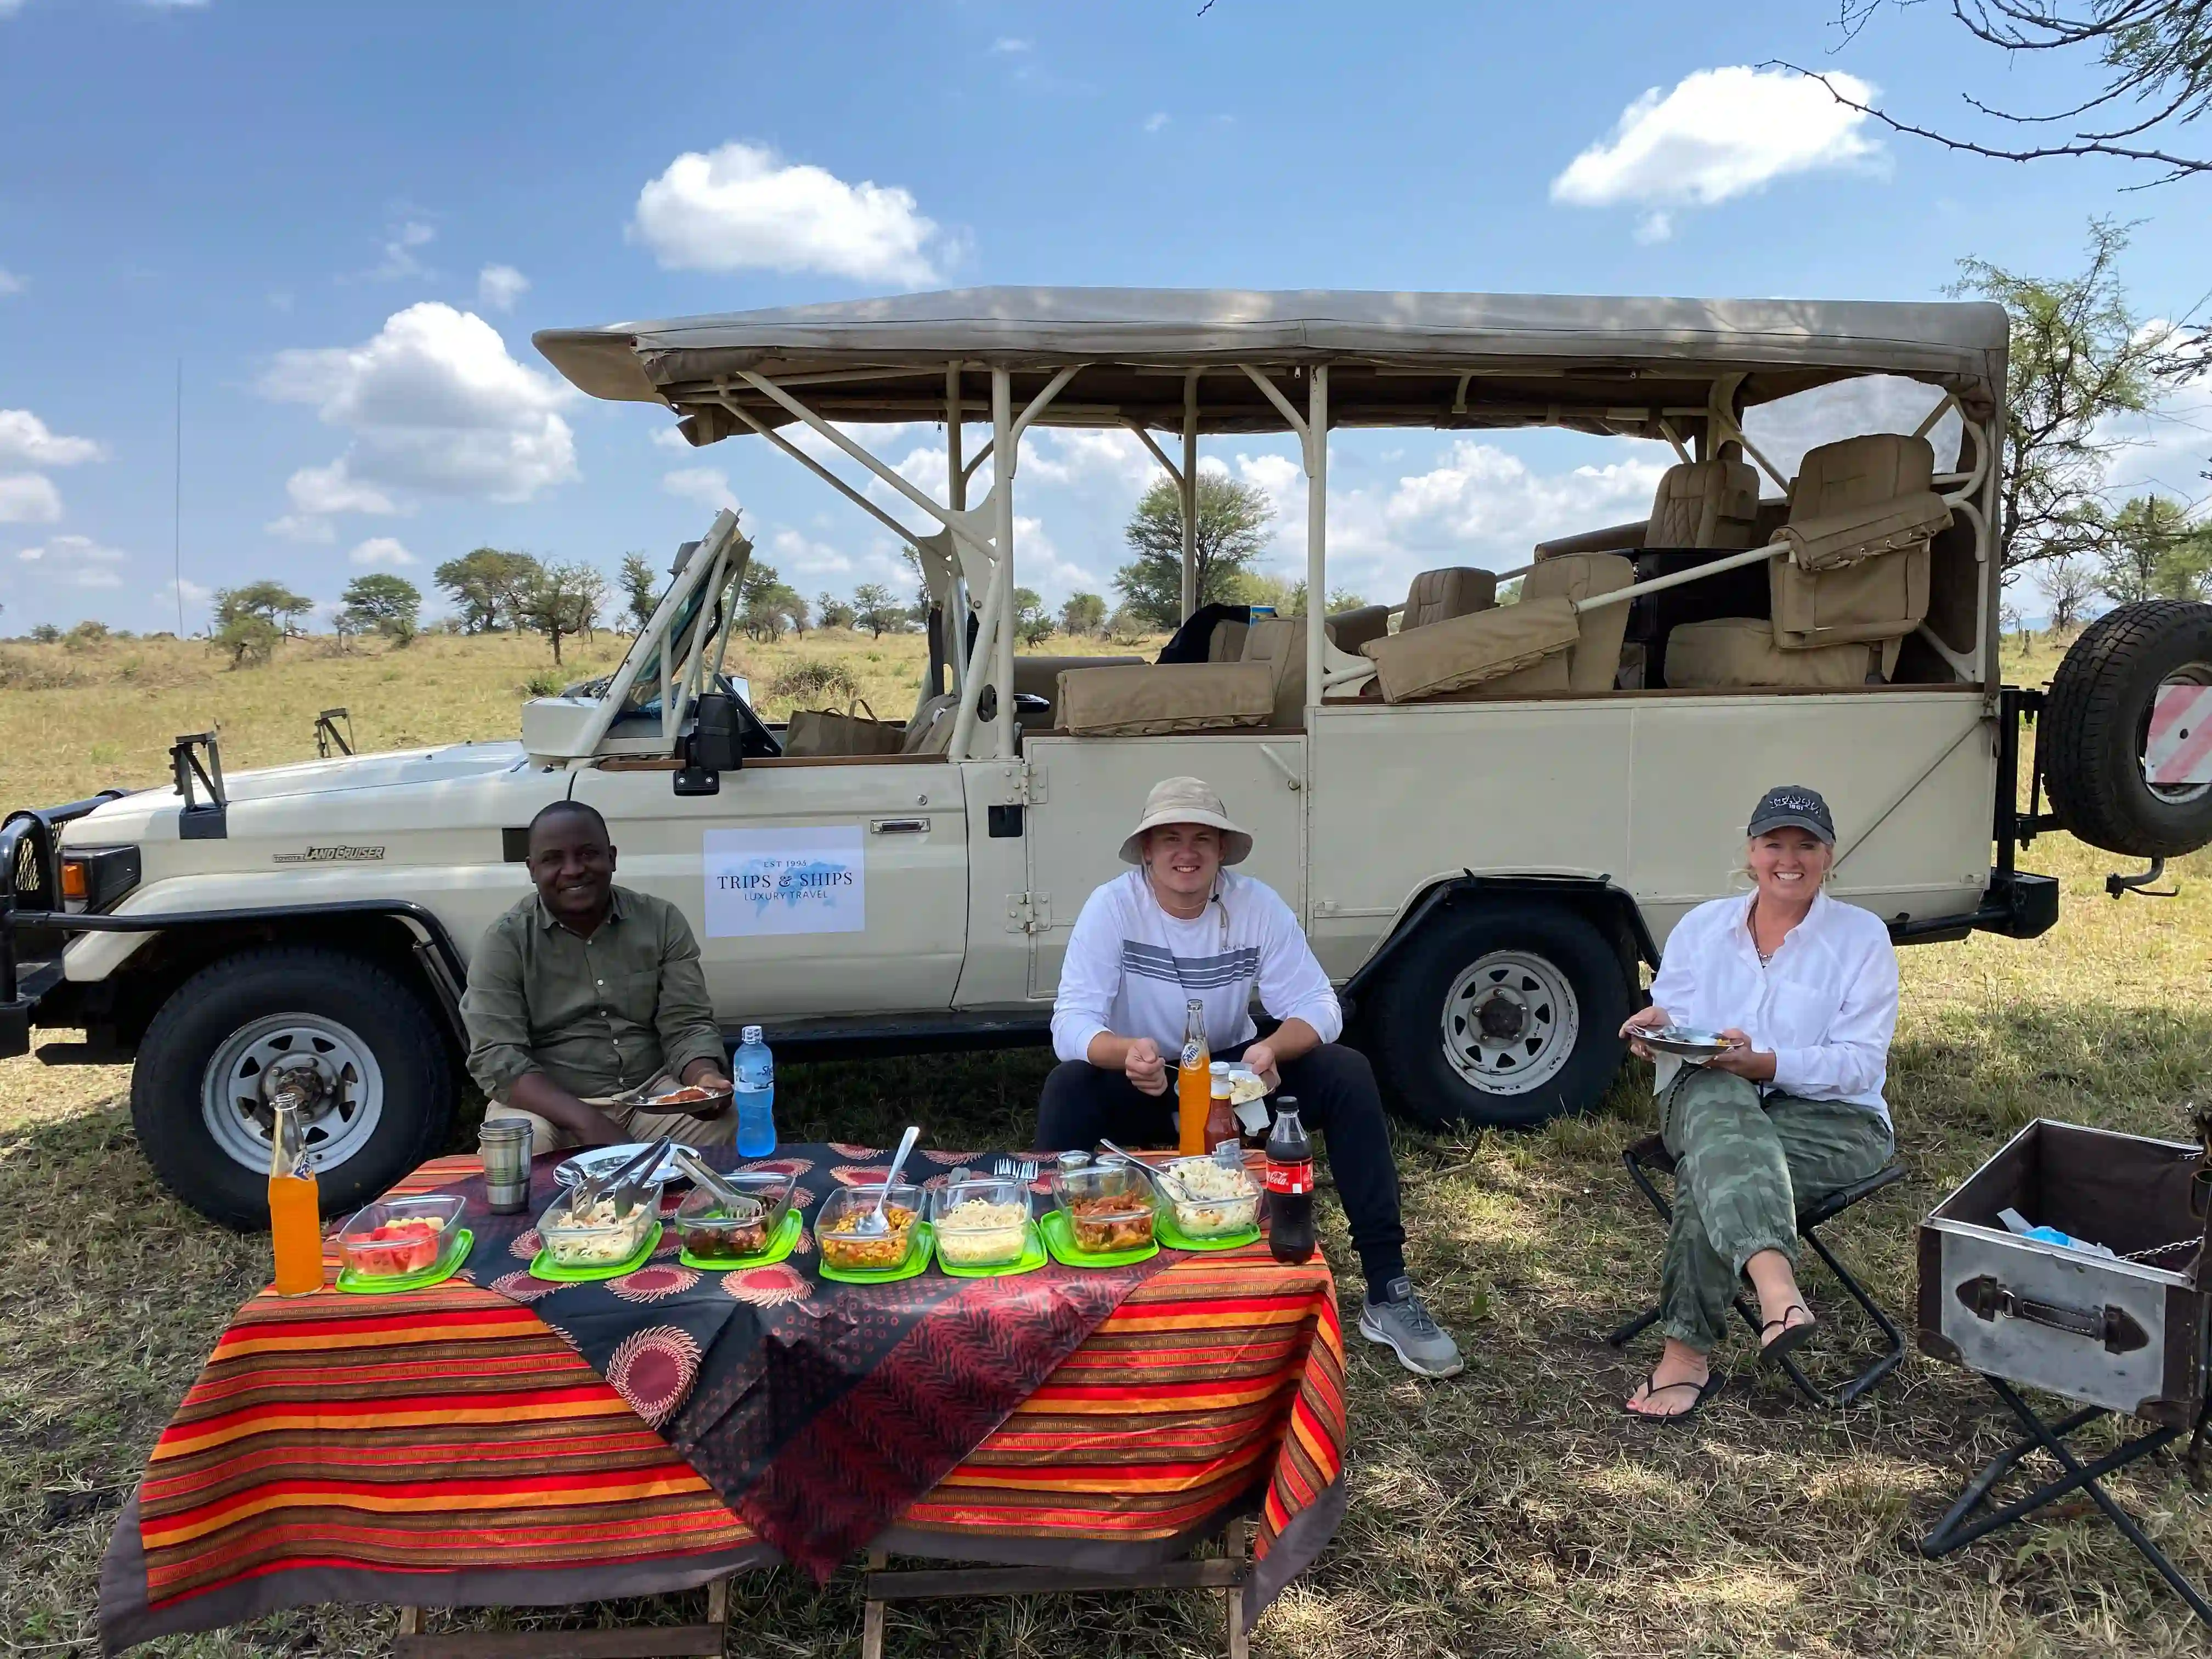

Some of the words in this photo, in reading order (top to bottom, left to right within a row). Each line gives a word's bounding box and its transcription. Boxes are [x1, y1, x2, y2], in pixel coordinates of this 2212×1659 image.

[717, 874, 771, 889] TRIPS
[778, 876, 792, 887] &
[800, 872, 853, 887] SHIPS
[744, 892, 785, 901] LUXURY
[789, 890, 827, 899] TRAVEL
